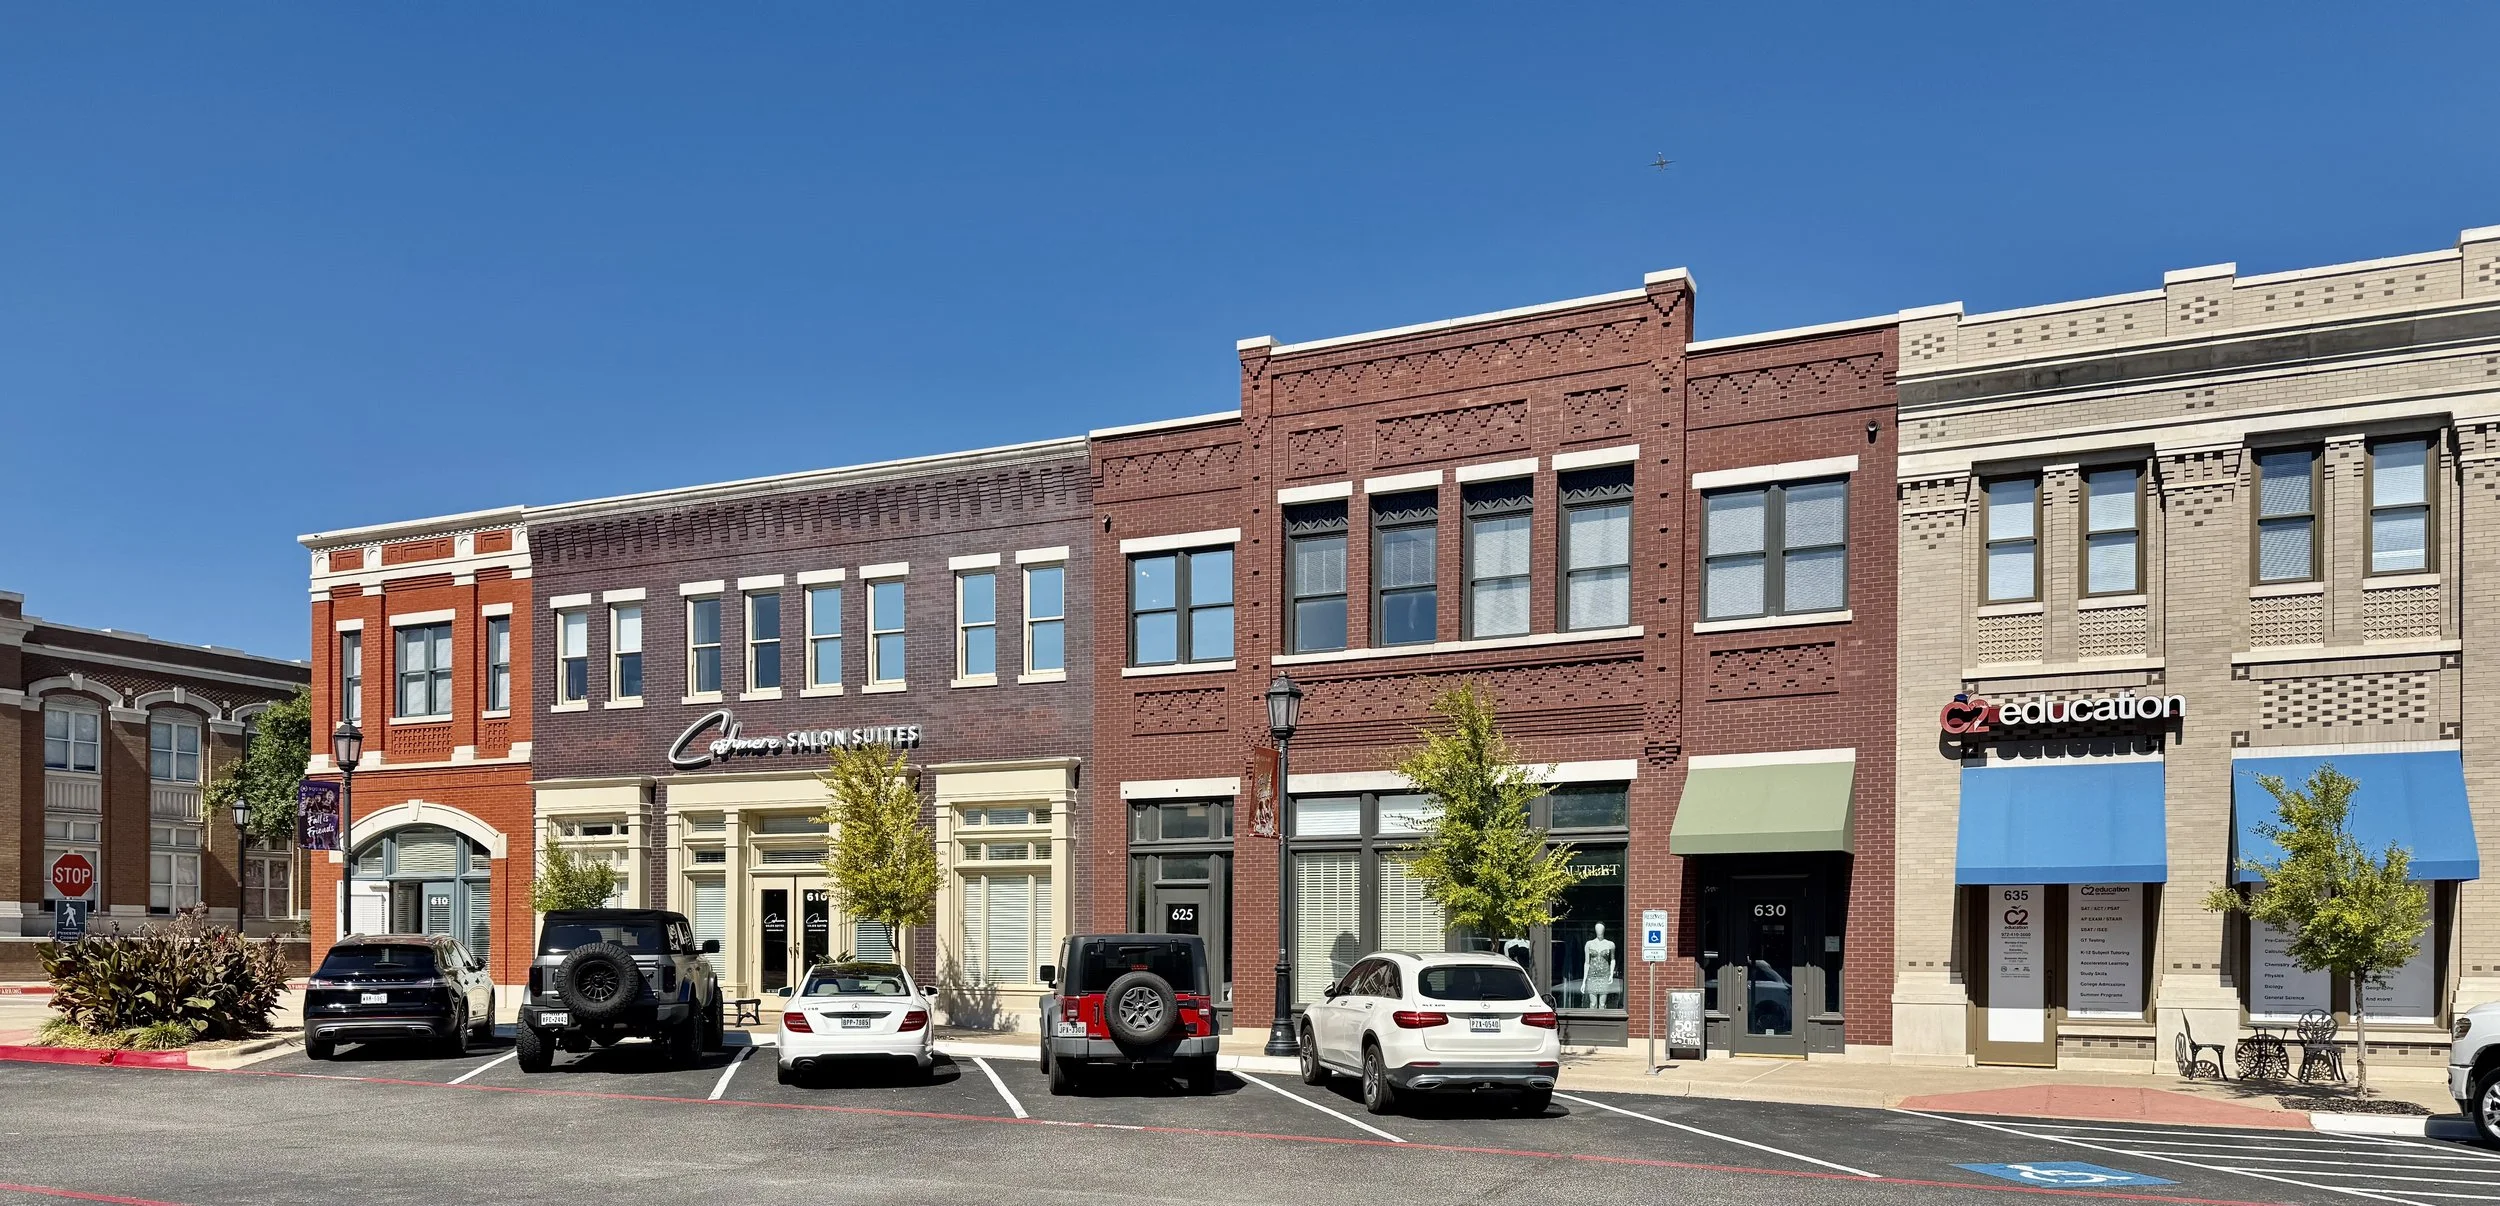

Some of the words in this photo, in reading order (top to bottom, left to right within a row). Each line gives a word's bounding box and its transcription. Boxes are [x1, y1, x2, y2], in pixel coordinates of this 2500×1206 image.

[1940, 698, 1990, 734] C2
[1998, 690, 2186, 726] education
[668, 708, 781, 764] Cashmere
[786, 729, 846, 747] SALON
[852, 726, 919, 745] SUITES
[307, 814, 322, 826] Fall
[306, 824, 334, 837] Friends
[54, 867, 90, 884] STOP
[806, 892, 828, 902] 610
[2004, 890, 2028, 900] 635
[2081, 886, 2094, 896] C2
[430, 896, 448, 905] 610
[1172, 908, 1194, 920] 625
[1754, 904, 1786, 916] 630
[2004, 910, 2028, 926] C2
